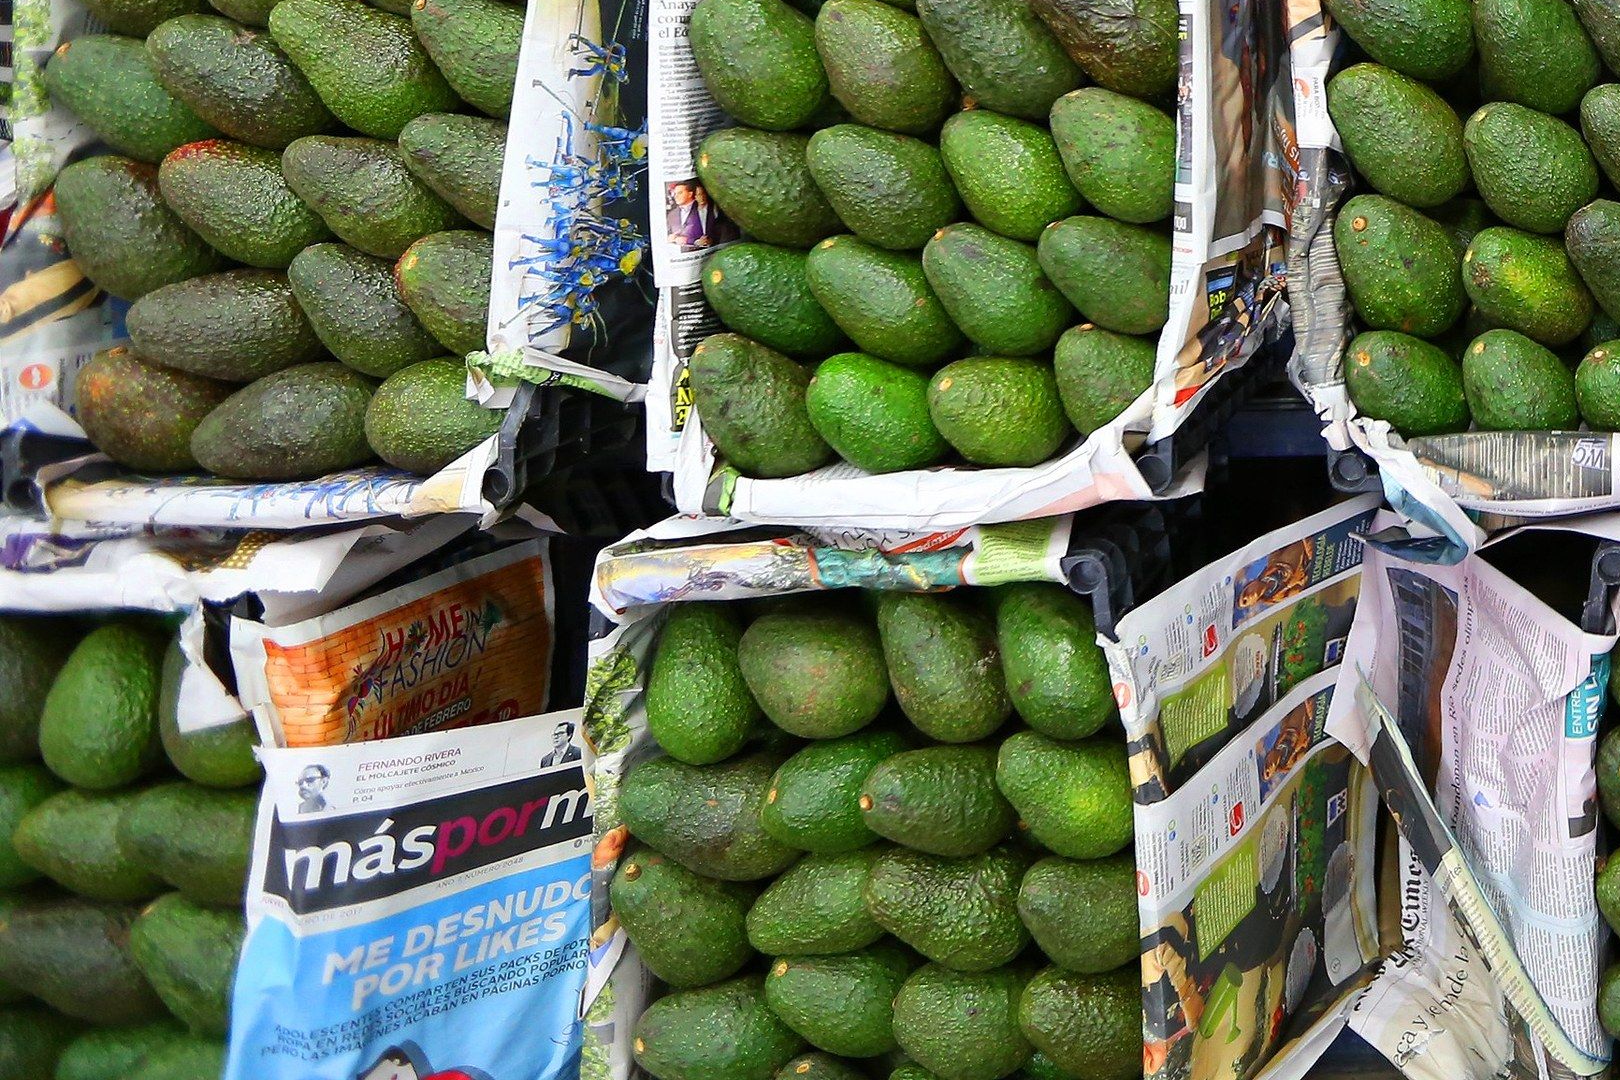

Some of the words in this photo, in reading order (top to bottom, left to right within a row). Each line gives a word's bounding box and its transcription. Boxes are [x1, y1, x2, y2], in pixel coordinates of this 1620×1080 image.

[374, 632, 486, 703] FASHION
[424, 699, 472, 732] FEBRERO
[1586, 698, 1600, 733] SIN
[356, 773, 367, 782] EL
[368, 767, 420, 781] MOLCAJETE
[420, 759, 456, 772] CÓSMICO
[358, 757, 424, 772] FERNANDO
[424, 747, 462, 764] RIVERA
[377, 781, 404, 795] apoyar
[404, 773, 453, 788] efectivamente
[322, 935, 394, 985] ME
[352, 951, 446, 1011] POR
[453, 911, 569, 972] LIKES
[384, 976, 468, 1013] COMPARTEN
[470, 965, 498, 982] SUS
[499, 952, 543, 972] PACKS
[544, 946, 560, 960] DE
[385, 995, 453, 1024] SOCIALES
[453, 975, 528, 996] BUSCANDO
[403, 1000, 460, 1027] ACABAN
[460, 993, 479, 1007] EN
[480, 975, 541, 999] PÁGINAS
